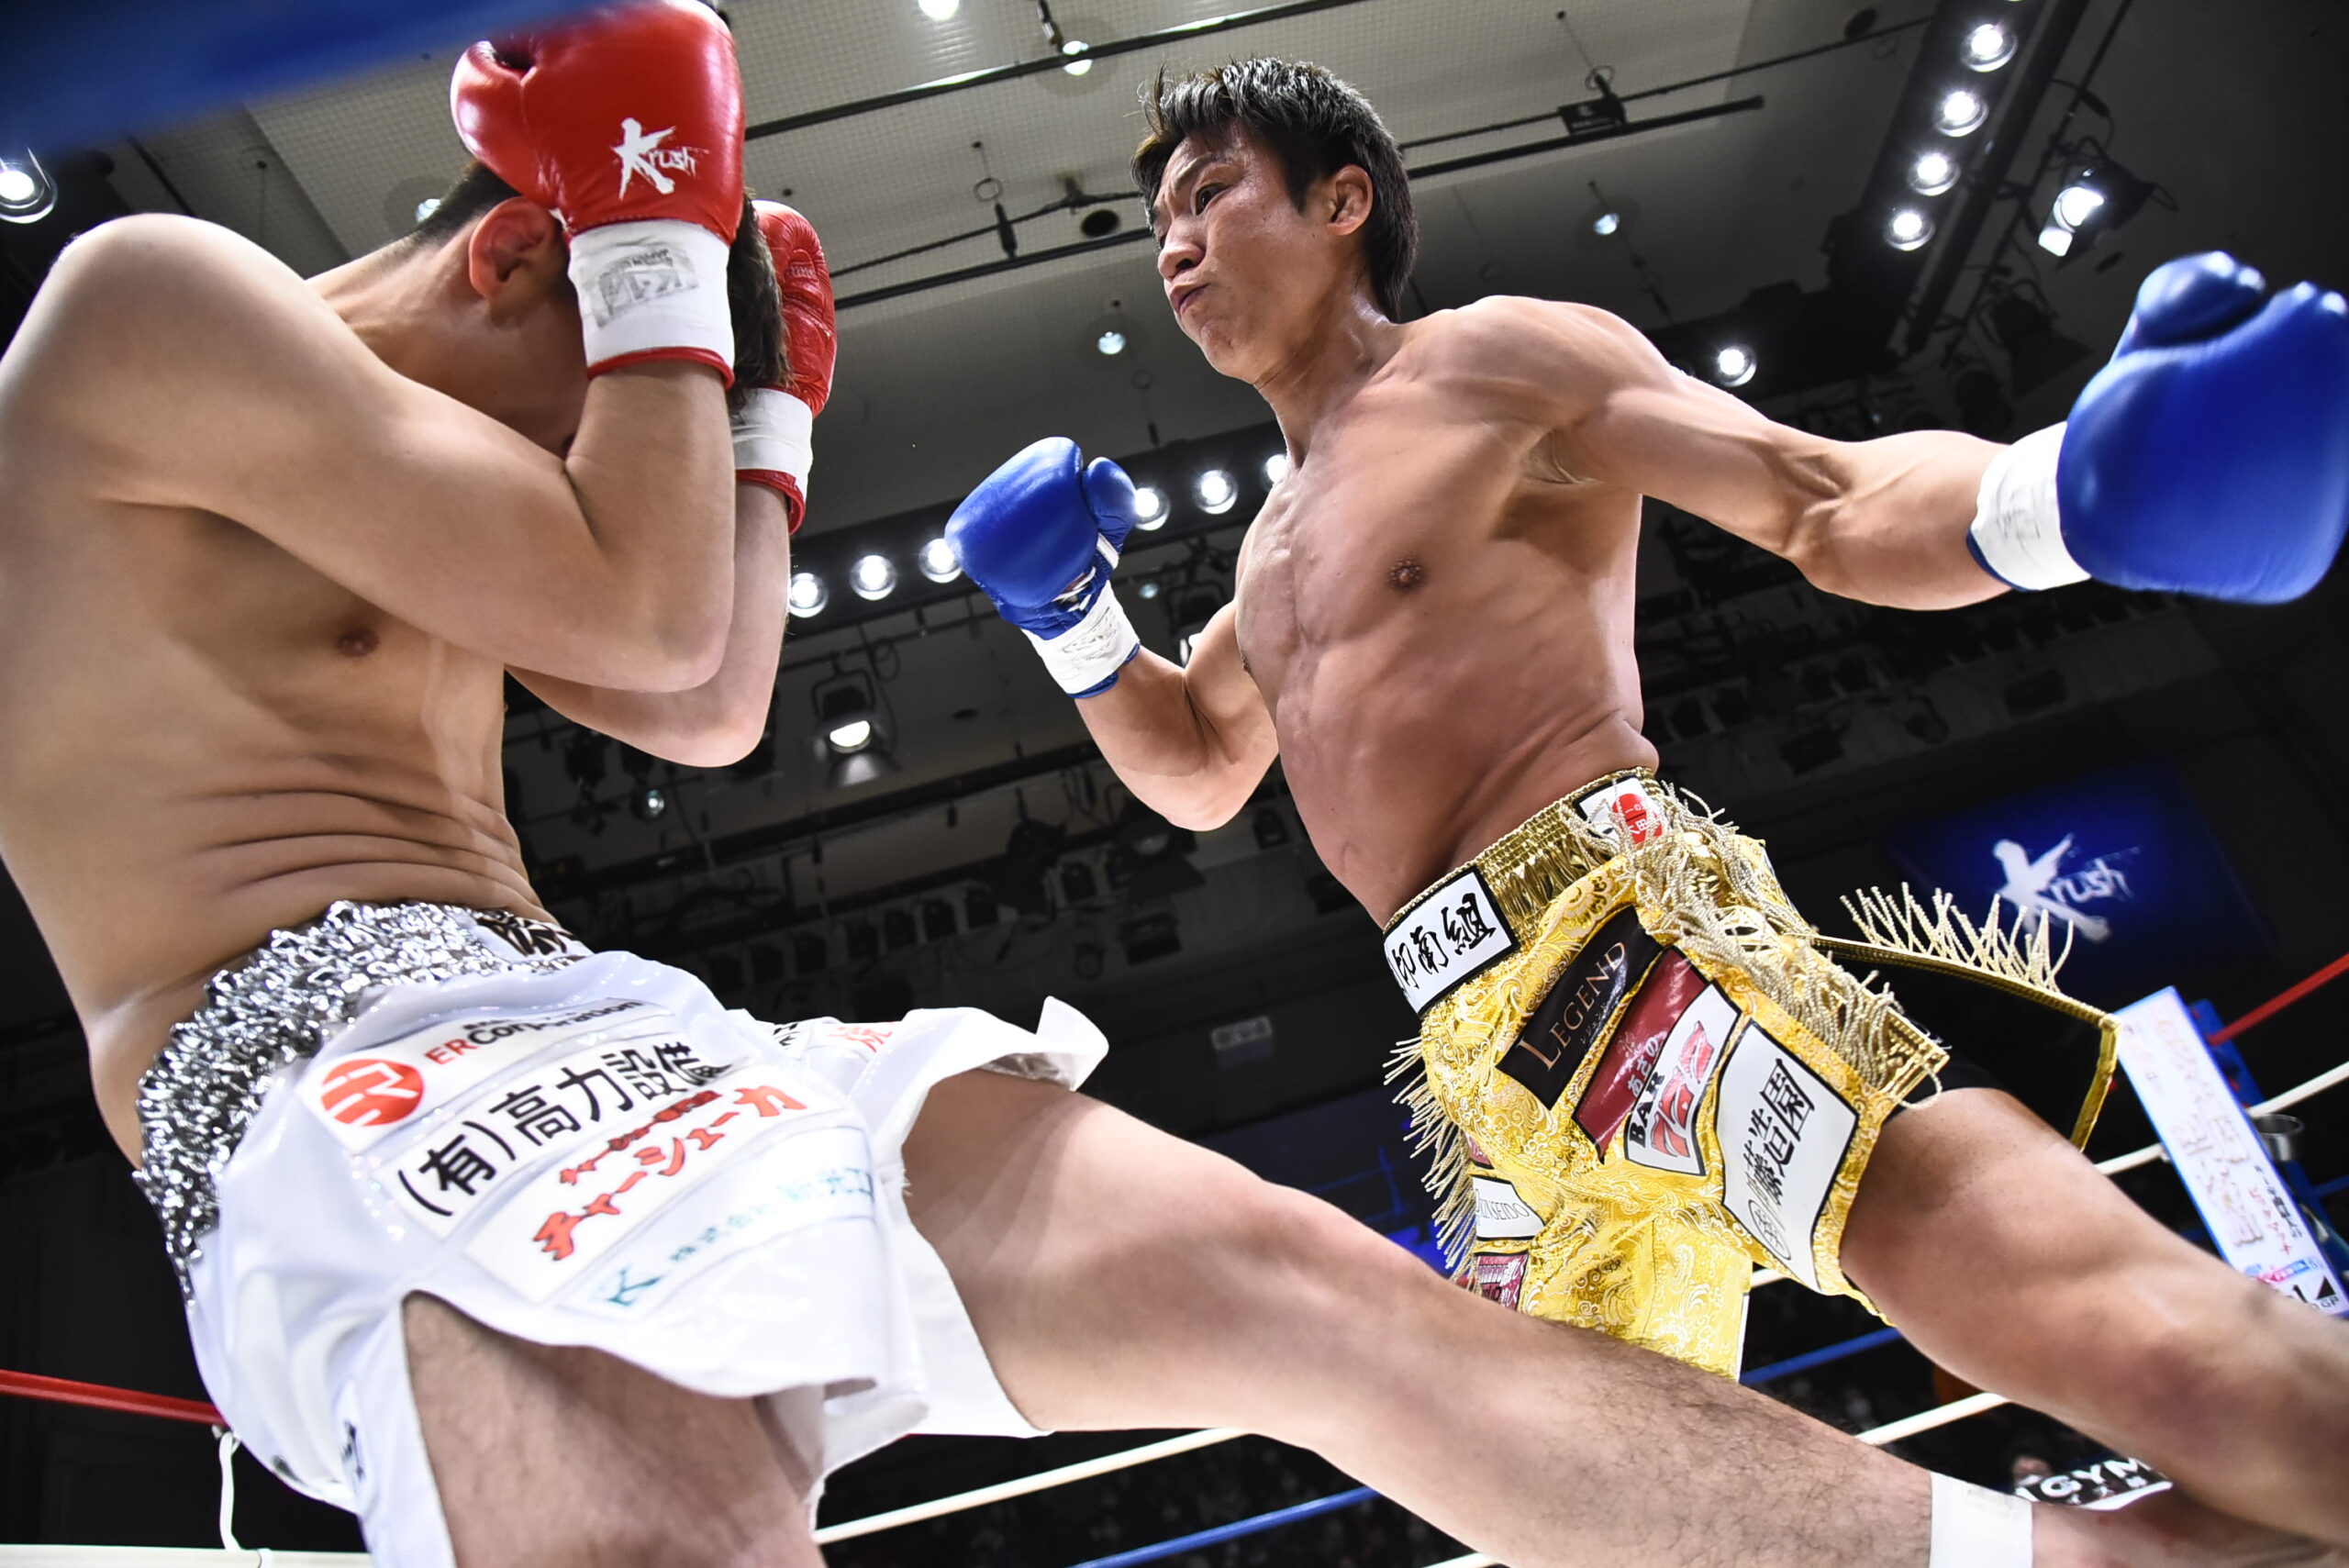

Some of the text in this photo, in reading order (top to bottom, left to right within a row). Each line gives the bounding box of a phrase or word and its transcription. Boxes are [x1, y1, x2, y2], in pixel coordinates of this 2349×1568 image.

[611, 117, 701, 200] Krush
[1989, 832, 2140, 944] Krush
[1515, 941, 1626, 1072] LEGEND
[1629, 1071, 1665, 1149] BAR
